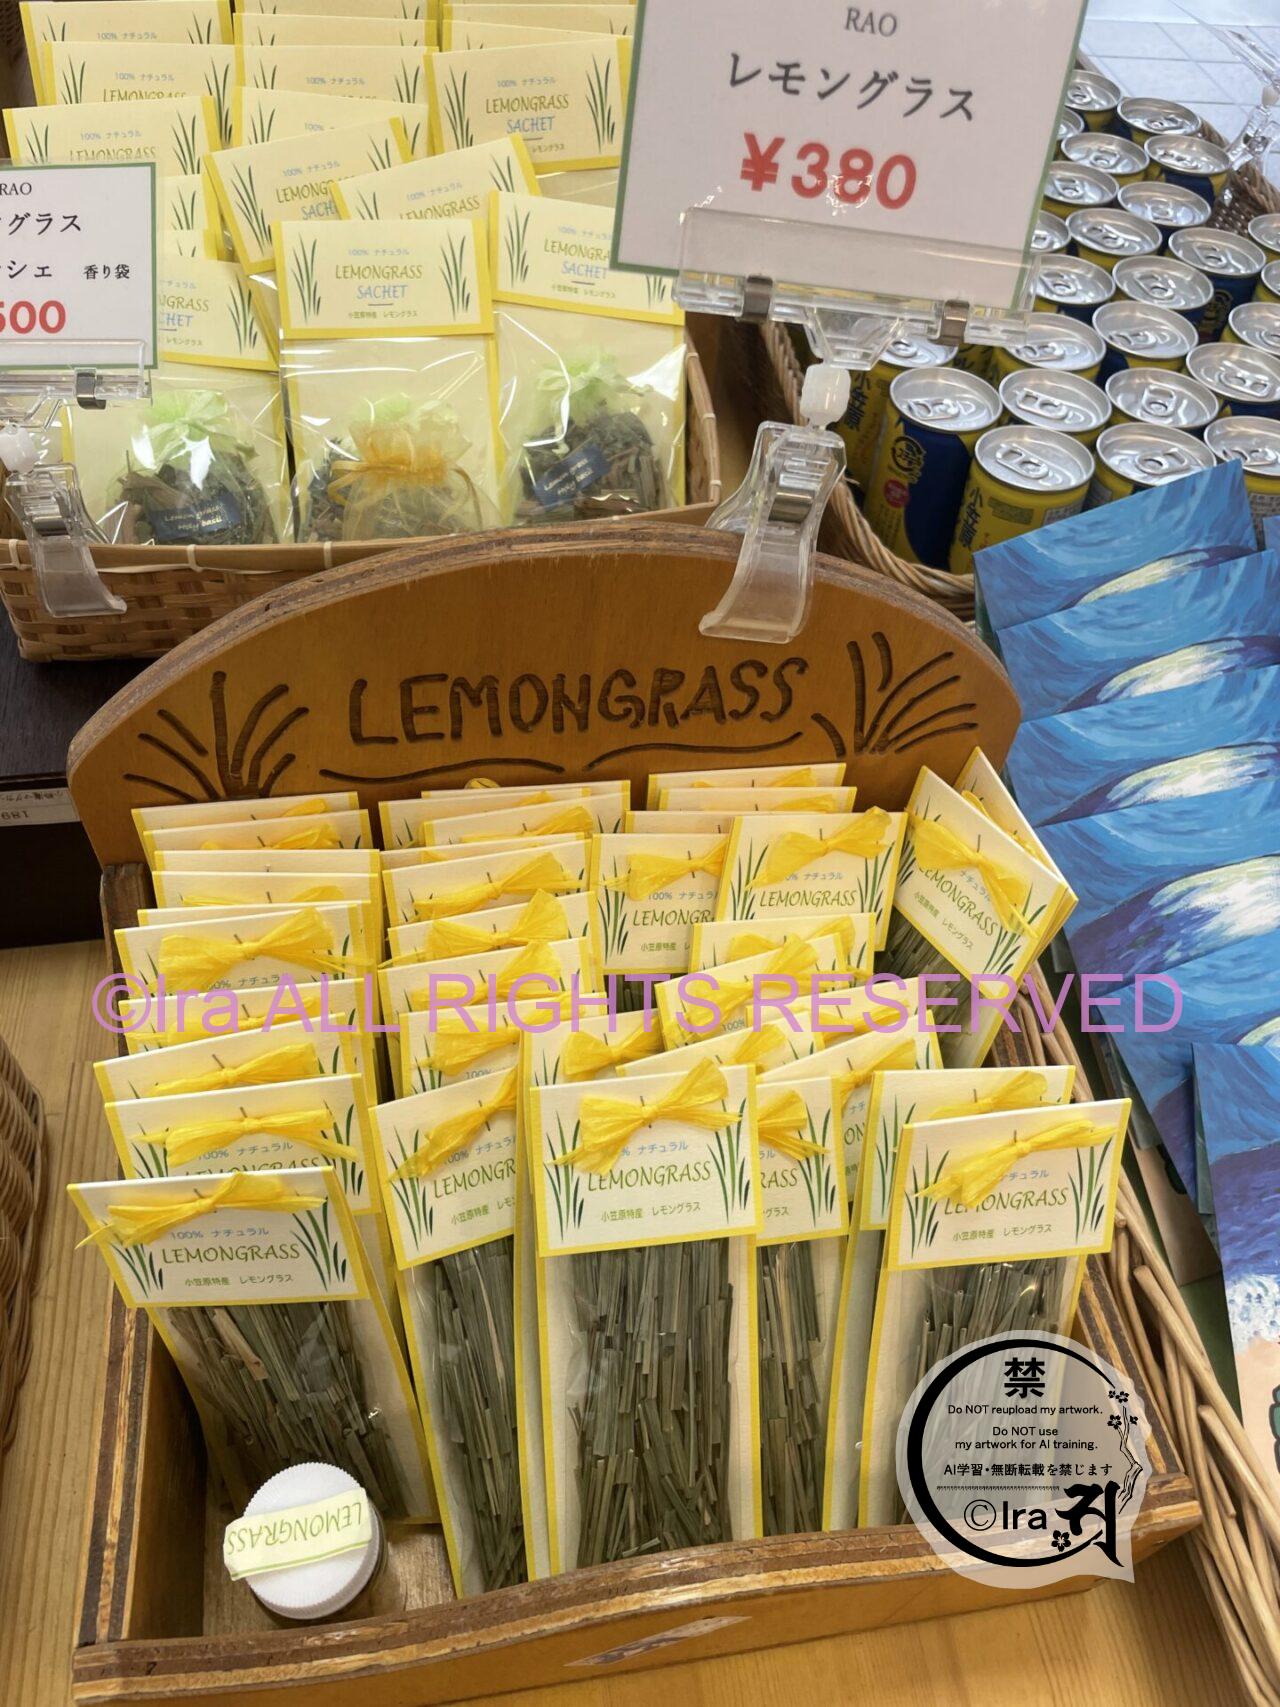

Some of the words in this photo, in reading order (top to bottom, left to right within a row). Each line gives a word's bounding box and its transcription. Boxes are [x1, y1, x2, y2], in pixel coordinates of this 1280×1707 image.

[844, 7, 898, 37] RAO
[729, 53, 974, 120] レモングラス
[485, 93, 570, 114] LEMONGRASS
[506, 115, 556, 134] SACHET
[740, 132, 917, 211] ¥380
[0, 182, 32, 196] RAO
[301, 200, 338, 221] SACH
[83, 264, 130, 280] 香り袋
[335, 264, 423, 280] LEMONGRASS
[561, 259, 609, 280] SACHET
[356, 285, 409, 299] SACHET
[0, 300, 66, 334] 00
[161, 312, 194, 328] HET
[349, 657, 808, 745] LEMONGRASS
[760, 889, 857, 908] LEMONGRASS
[633, 909, 716, 927] LEMONGR
[239, 974, 280, 987] ナチュラ
[199, 1149, 229, 1160] 00%
[237, 1142, 293, 1157] ナチュラル
[445, 1150, 469, 1165] 00%
[475, 1135, 516, 1155] ナチュラ
[636, 1140, 689, 1155] ナチュラル
[433, 1157, 516, 1199] LEMONGR
[588, 1160, 712, 1192] LEMONGRASS
[1004, 1169, 1049, 1181] チュラル
[944, 1187, 1069, 1215] LEONGRASS
[601, 1208, 643, 1222] 小笠原特産
[652, 1201, 701, 1216] レモングラス
[171, 1230, 204, 1240] 100%
[210, 1227, 270, 1237] ナチュラル
[1003, 1224, 1052, 1237] レモングラス
[162, 1242, 301, 1264] LEMONGRASS
[239, 1274, 294, 1285] レモングラス
[227, 1501, 362, 1556] LEMONGRASS
